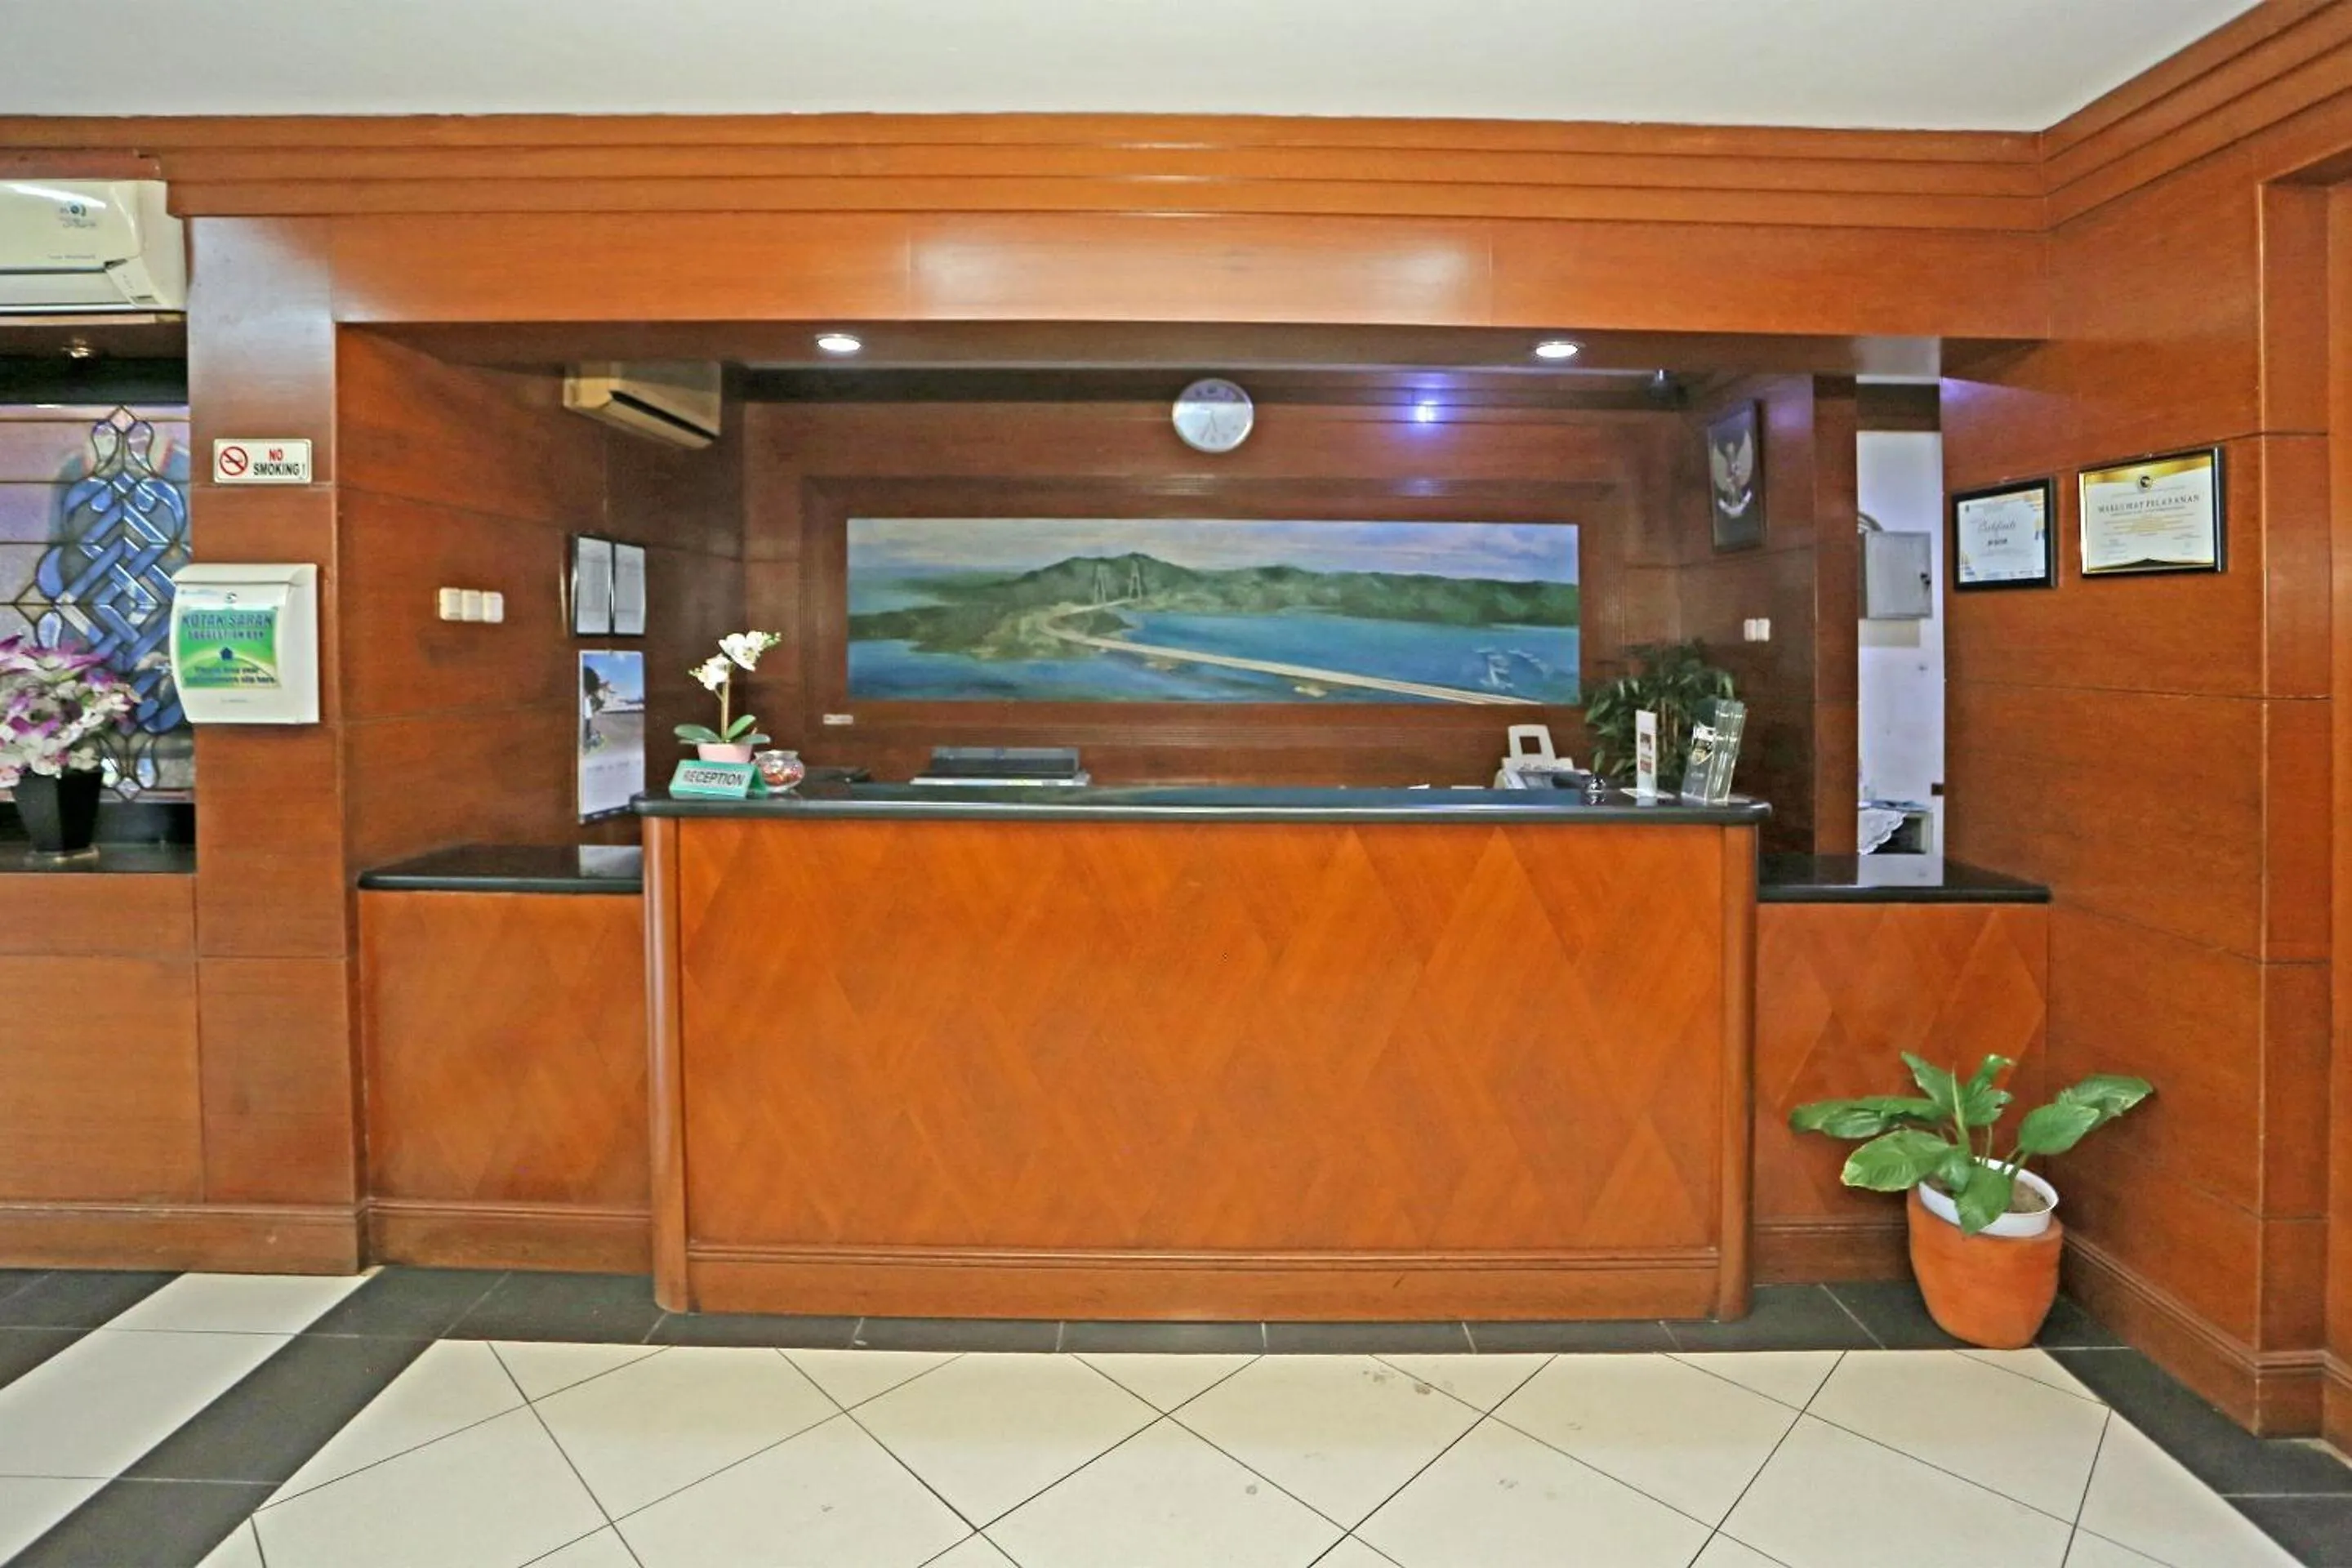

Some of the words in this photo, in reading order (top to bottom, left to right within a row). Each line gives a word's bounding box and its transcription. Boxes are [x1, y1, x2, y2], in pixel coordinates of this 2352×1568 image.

[269, 448, 283, 461] NO
[182, 613, 225, 629] KOTAK
[229, 613, 273, 629] SARAN
[684, 769, 745, 786] RECEPTION
